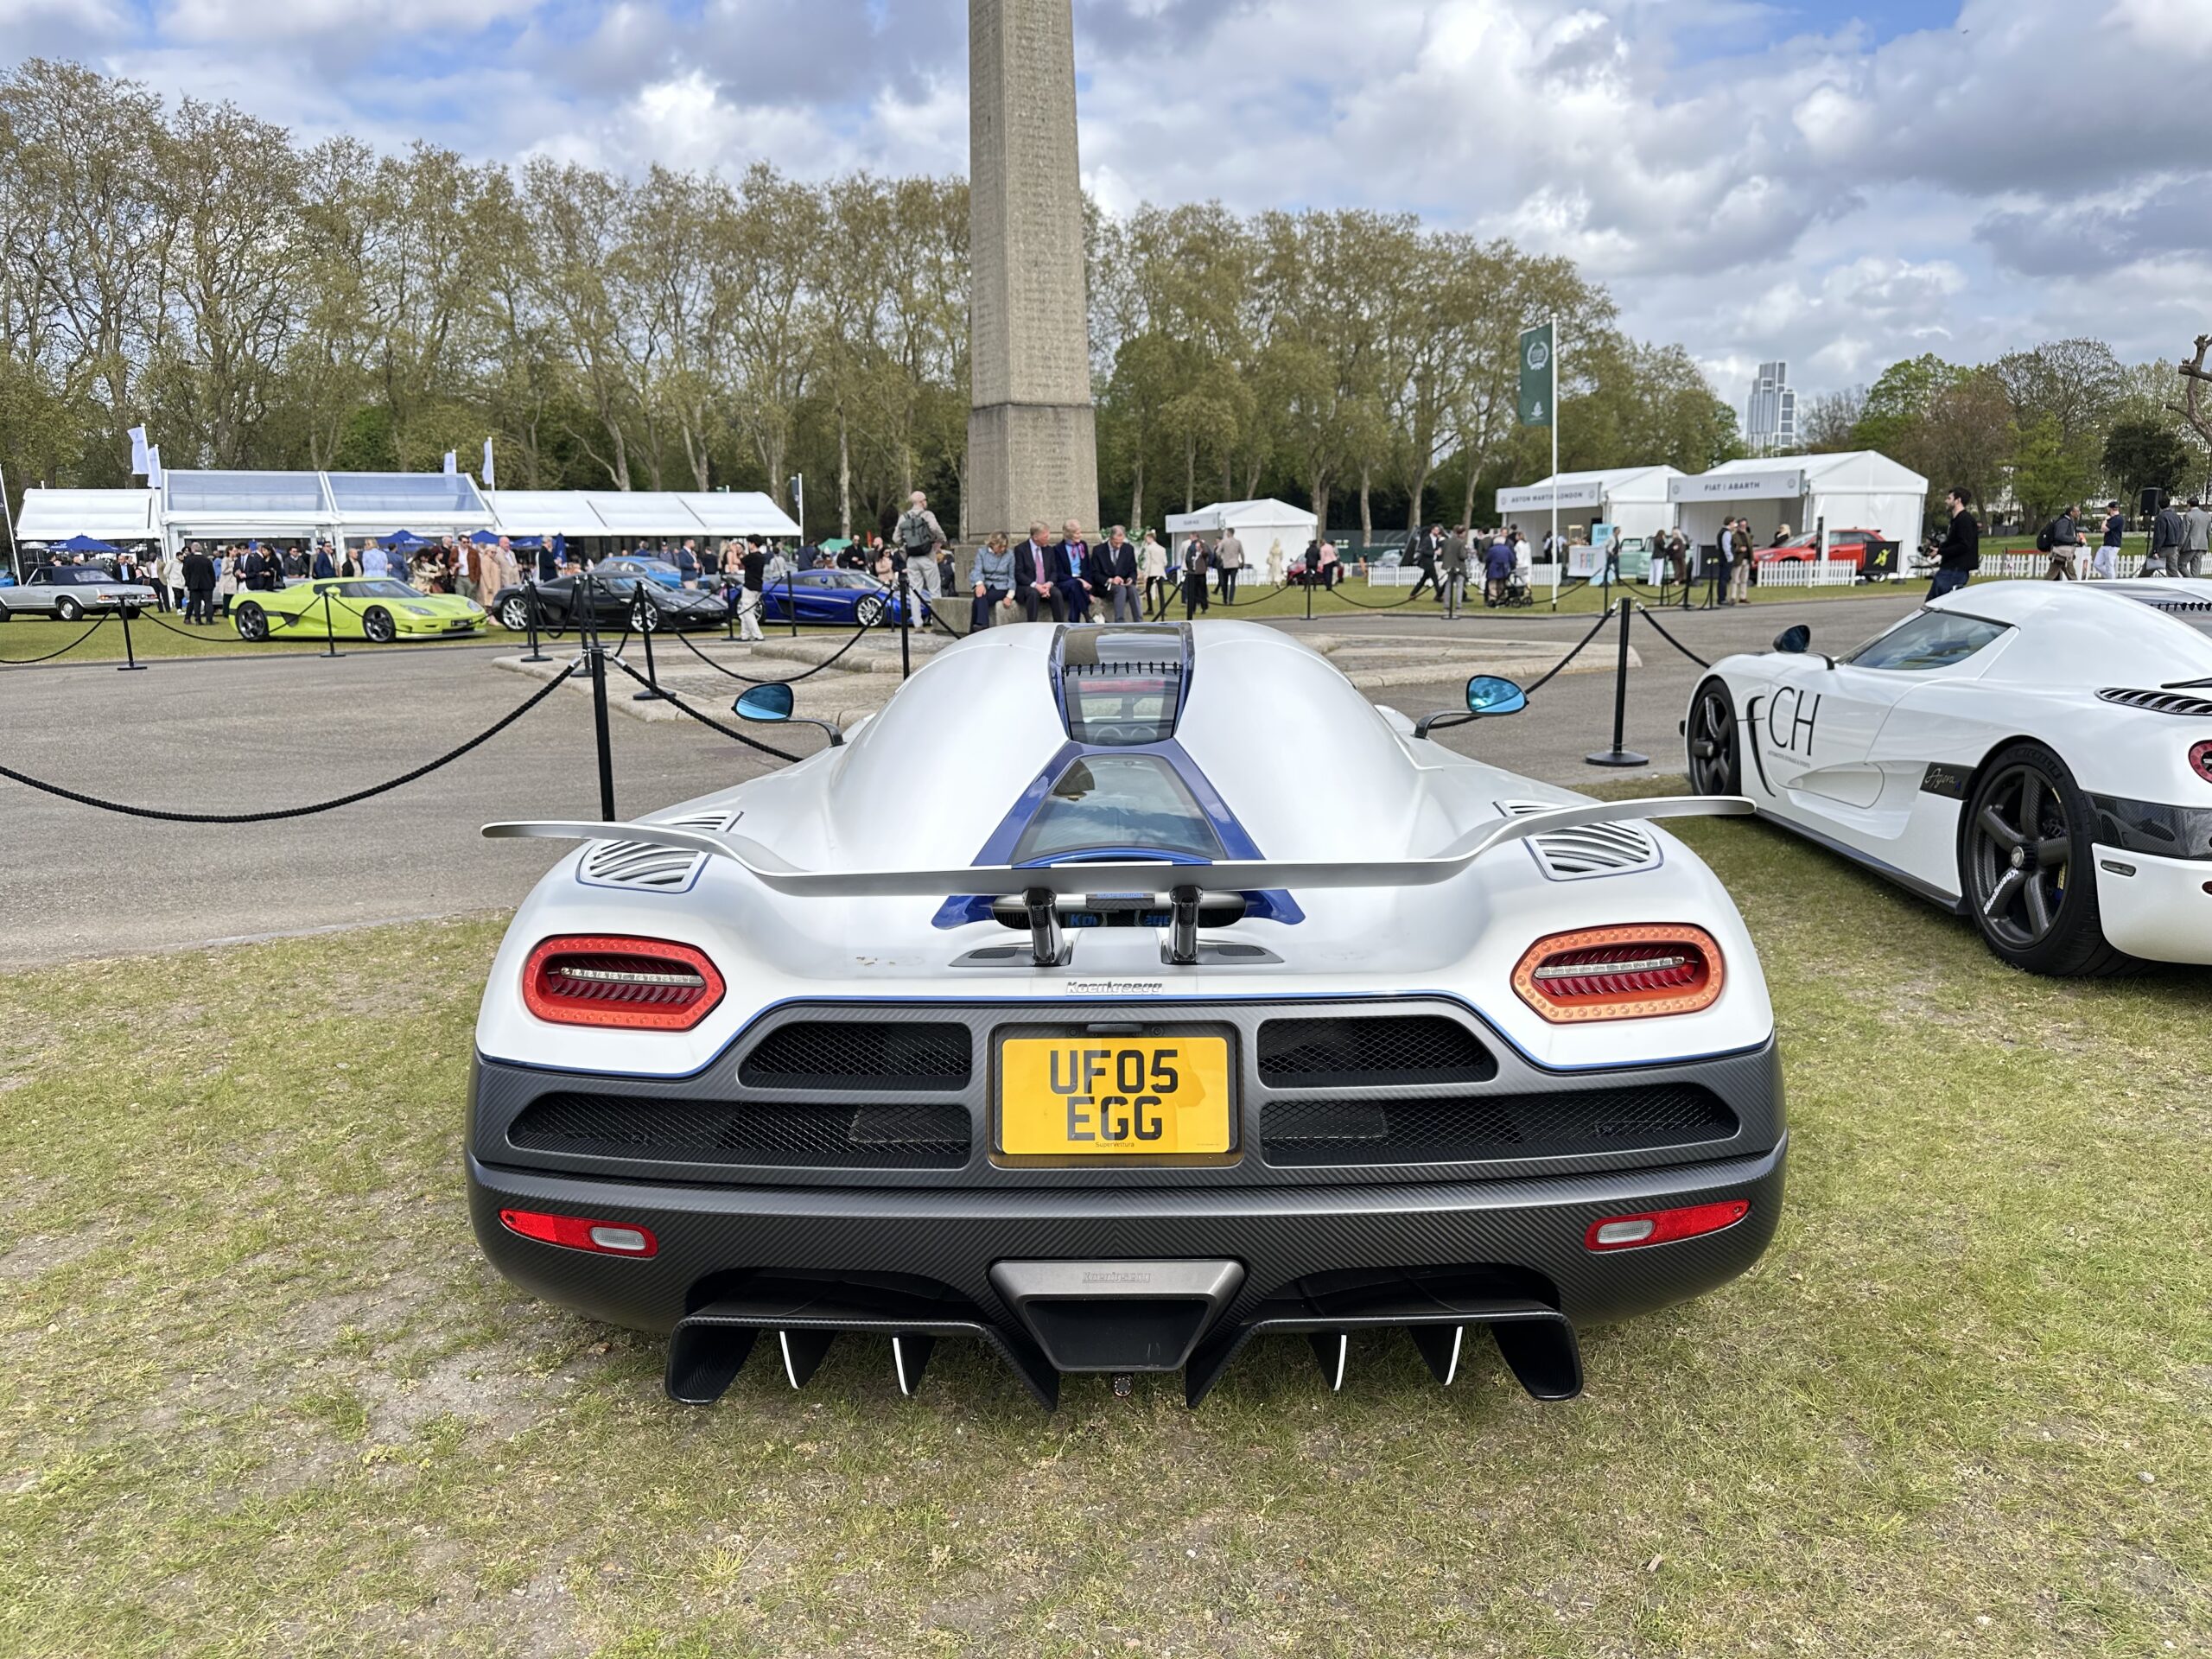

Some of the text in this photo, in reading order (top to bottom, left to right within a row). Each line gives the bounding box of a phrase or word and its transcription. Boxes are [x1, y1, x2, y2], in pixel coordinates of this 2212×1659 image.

[1769, 685, 1821, 757] CH
[1066, 981, 1163, 996] Koenigsegg
[1050, 1049, 1179, 1095] UF05
[1067, 1096, 1163, 1141] EGG
